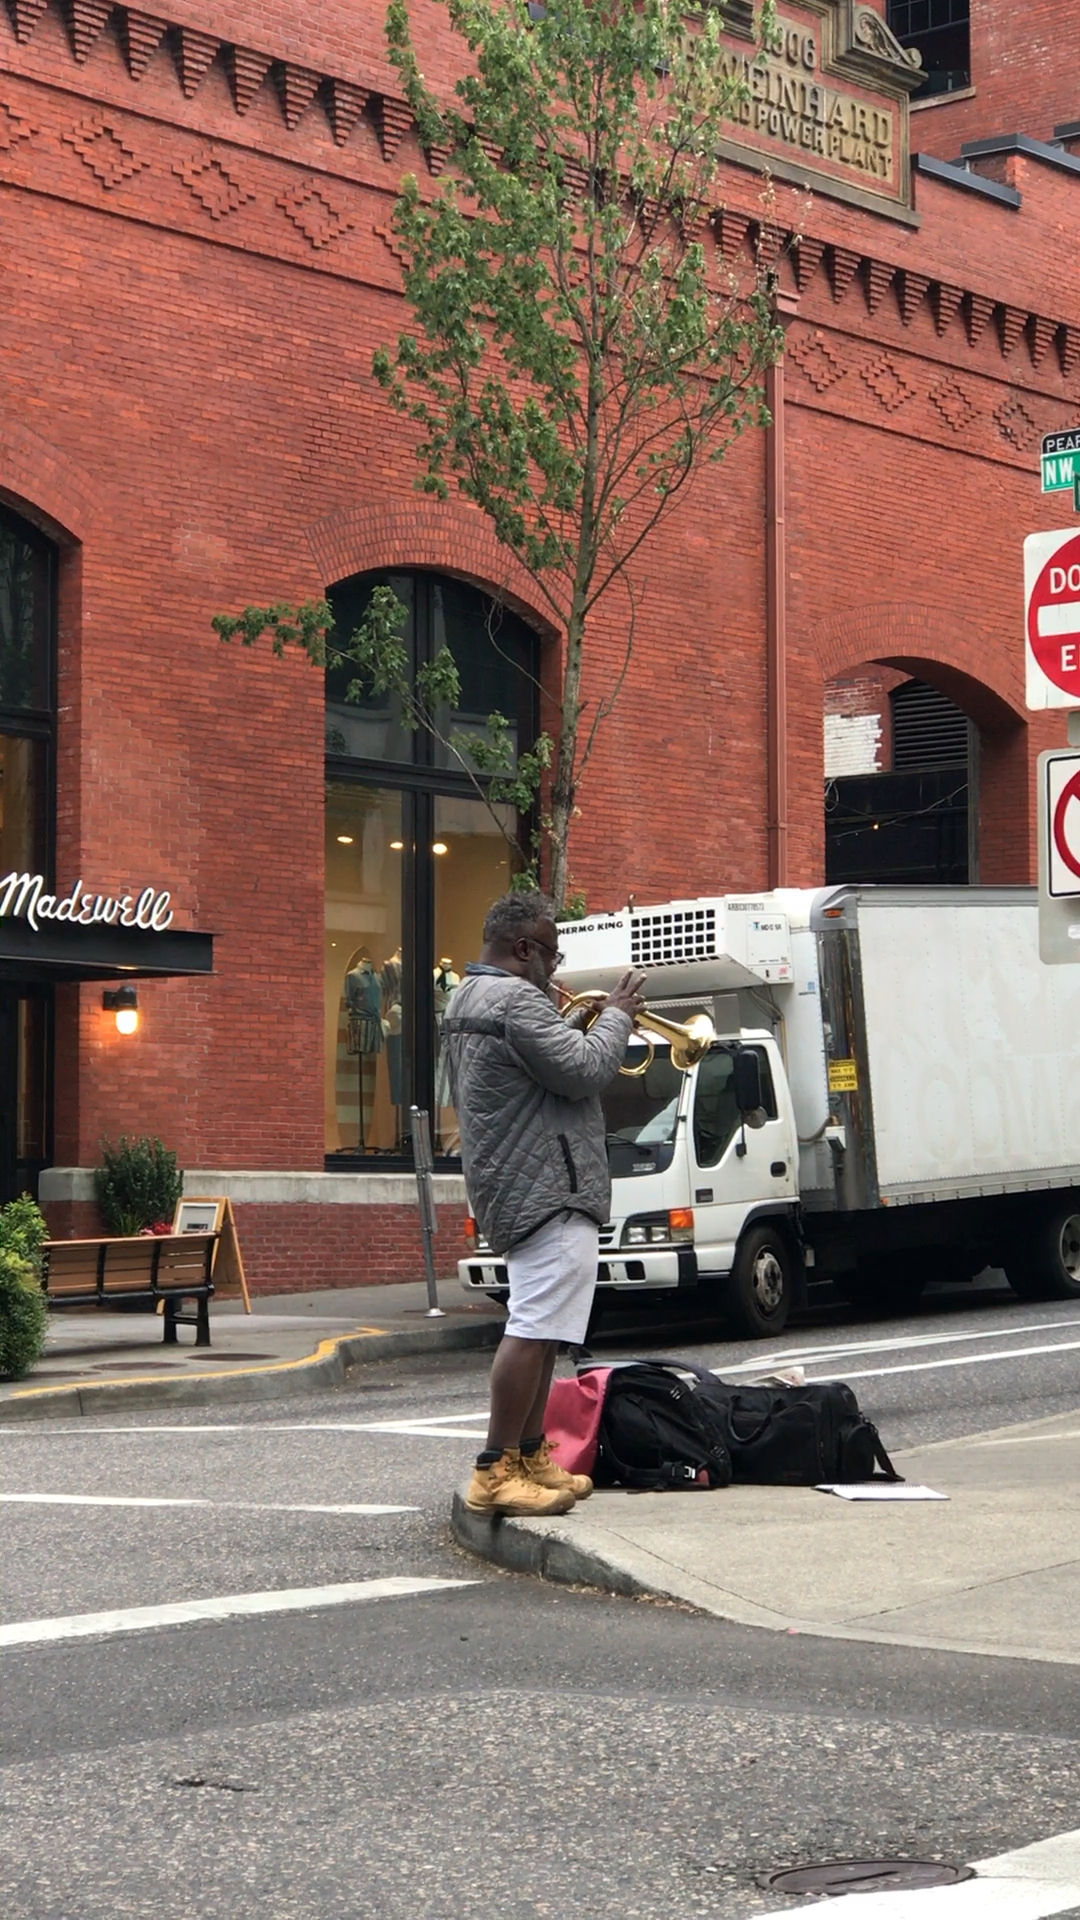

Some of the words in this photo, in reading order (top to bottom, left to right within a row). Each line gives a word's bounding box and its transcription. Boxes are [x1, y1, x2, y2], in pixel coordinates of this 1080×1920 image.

[755, 104, 825, 155] POWER
[828, 133, 892, 176] PLANT
[1045, 457, 1074, 485] NW
[1050, 564, 1080, 594] DO
[1061, 644, 1080, 671] E
[0, 871, 173, 931] Madewell
[557, 925, 595, 935] HERMO
[597, 921, 623, 930] KING
